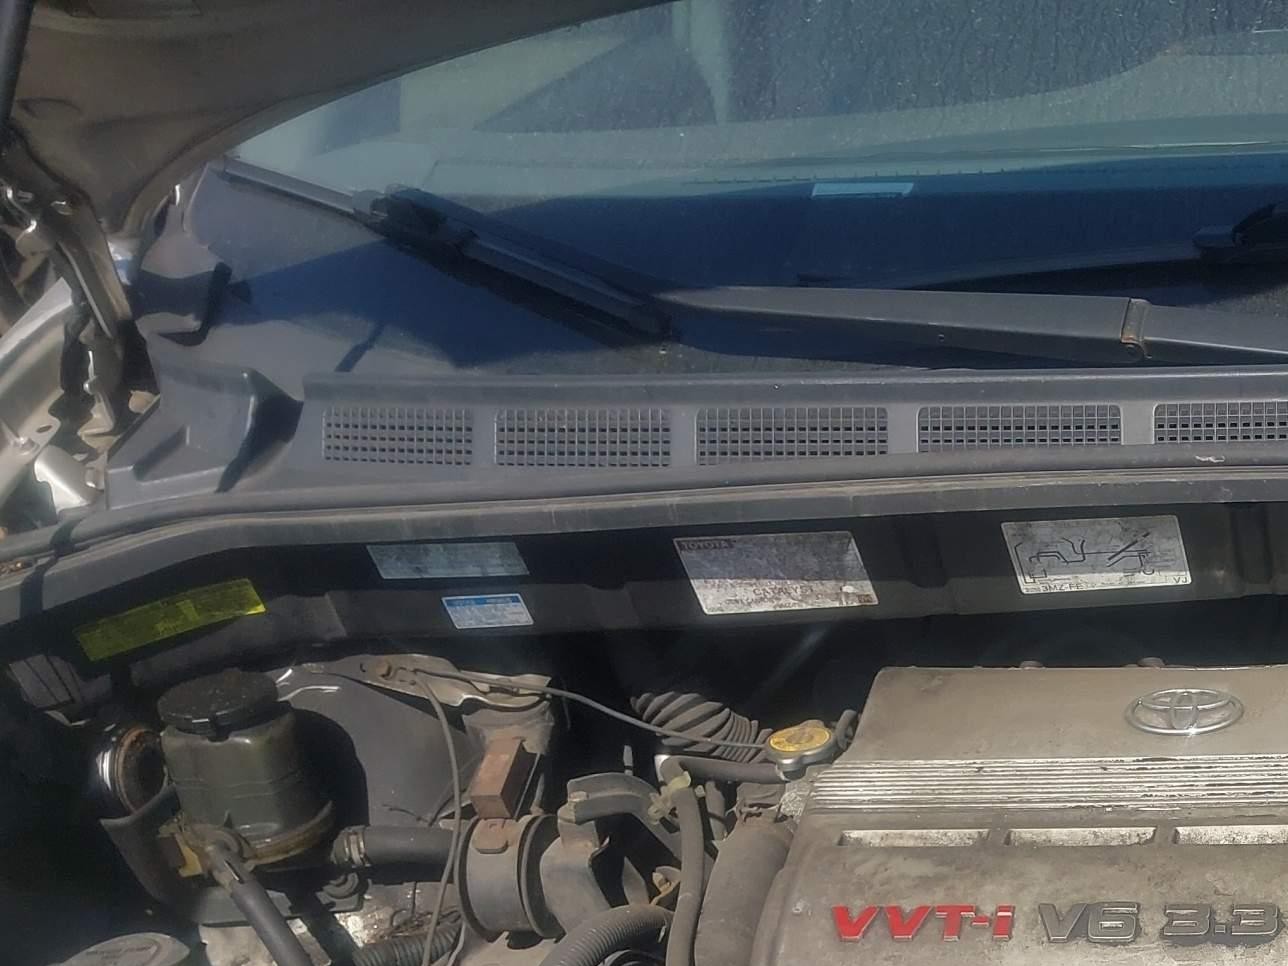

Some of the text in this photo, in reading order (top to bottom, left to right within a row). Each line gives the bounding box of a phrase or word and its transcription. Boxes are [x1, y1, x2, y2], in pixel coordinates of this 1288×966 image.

[681, 541, 730, 550] TOYOTA
[752, 585, 814, 597] CATALYST
[832, 902, 1284, 943] VVT-i V6 3.3
